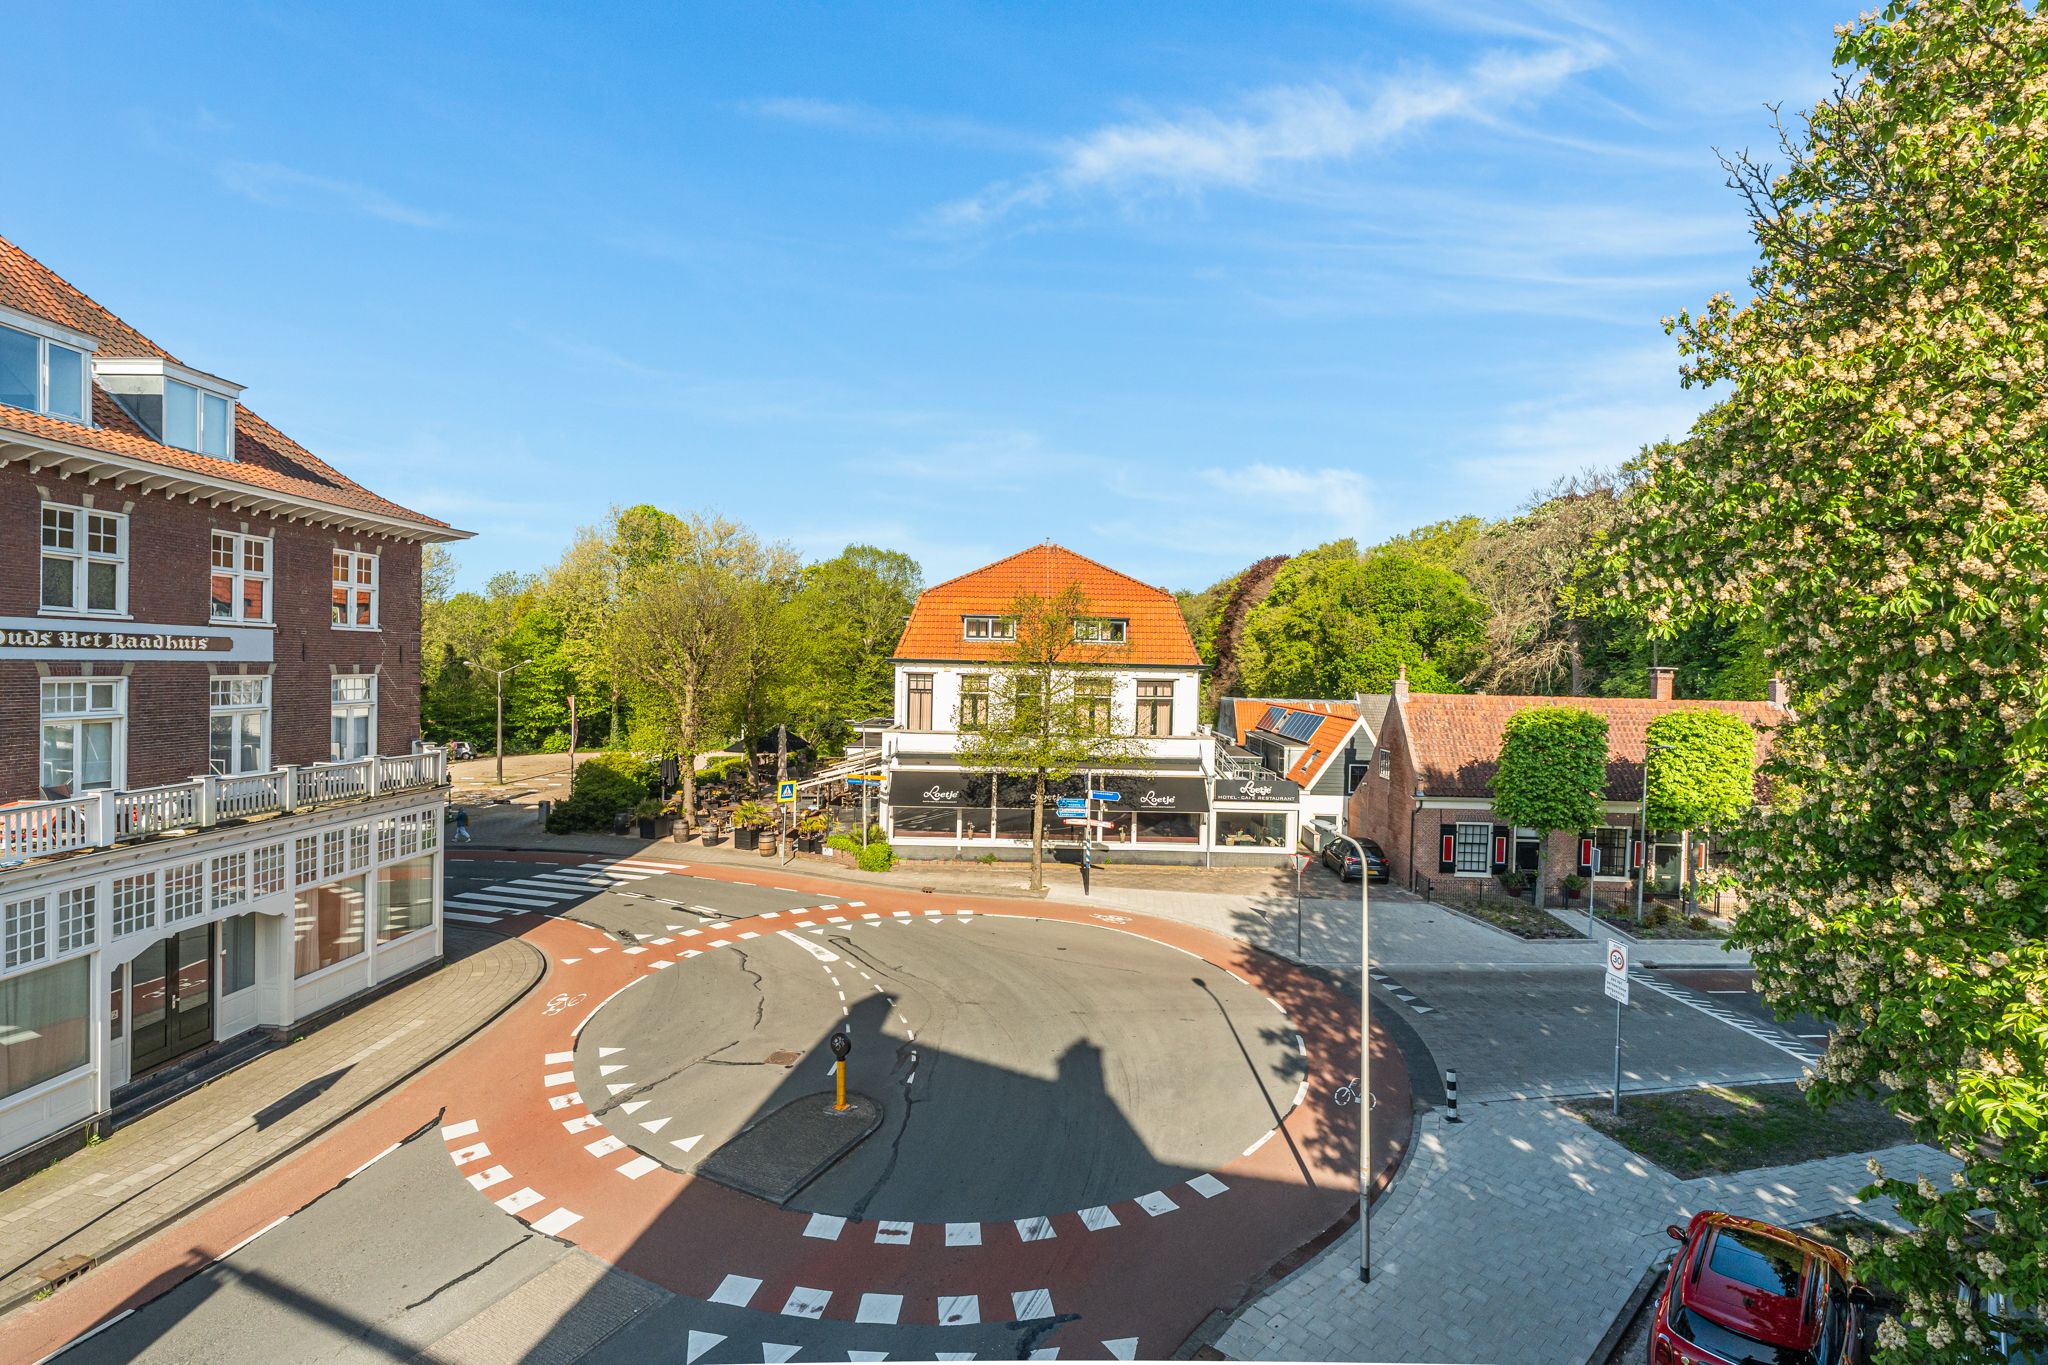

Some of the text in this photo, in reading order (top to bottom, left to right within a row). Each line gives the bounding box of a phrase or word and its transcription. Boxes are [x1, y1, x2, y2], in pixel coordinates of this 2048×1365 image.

[57, 631, 103, 648] Het
[105, 633, 209, 650] Raadhuis
[923, 785, 959, 801] Loetje
[1240, 780, 1272, 797] Loetje
[1140, 790, 1176, 806] Loetje
[1612, 954, 1622, 966] 30
